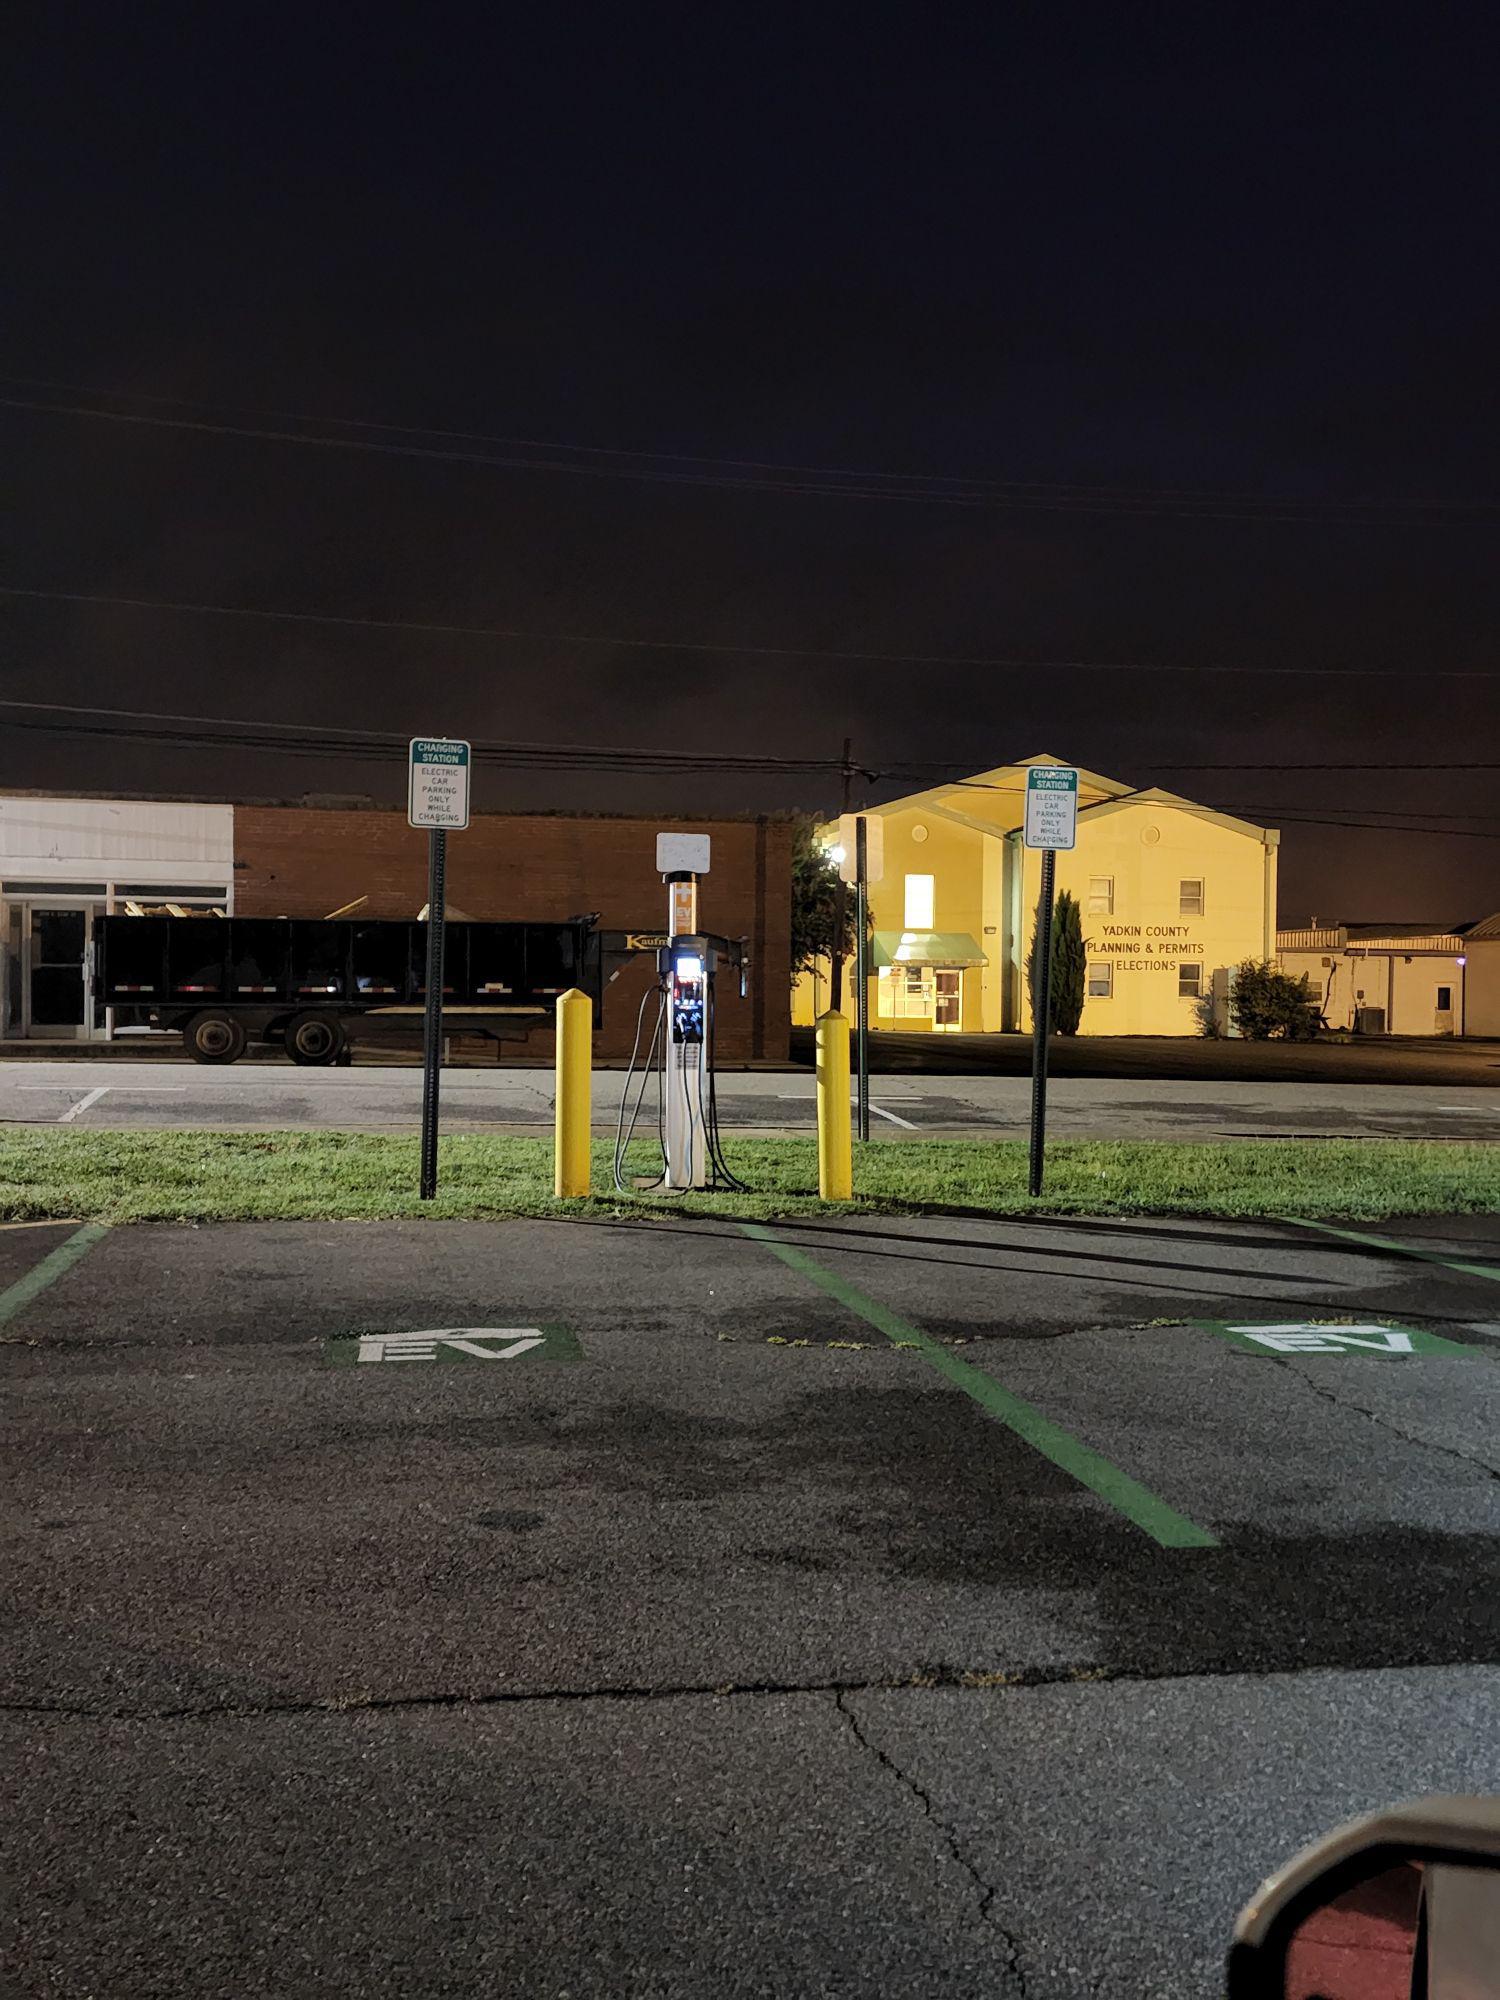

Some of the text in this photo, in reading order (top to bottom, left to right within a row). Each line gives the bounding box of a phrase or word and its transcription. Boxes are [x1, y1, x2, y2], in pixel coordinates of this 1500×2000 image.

[417, 743, 464, 753] CHARGING
[422, 753, 459, 763] STATION
[421, 768, 458, 776] ELECTRIC
[1032, 770, 1074, 780] CHARGING
[1036, 780, 1069, 789] STATION
[422, 786, 457, 794] PARKING
[418, 813, 460, 822] CHARGING
[1032, 836, 1068, 844] CHARGING
[1102, 925, 1190, 937] YADKIN COUNTY
[624, 935, 668, 949] Kaufm
[1087, 942, 1204, 954] PLANNING & PERMITS
[1116, 960, 1176, 971] ELECTIONS
